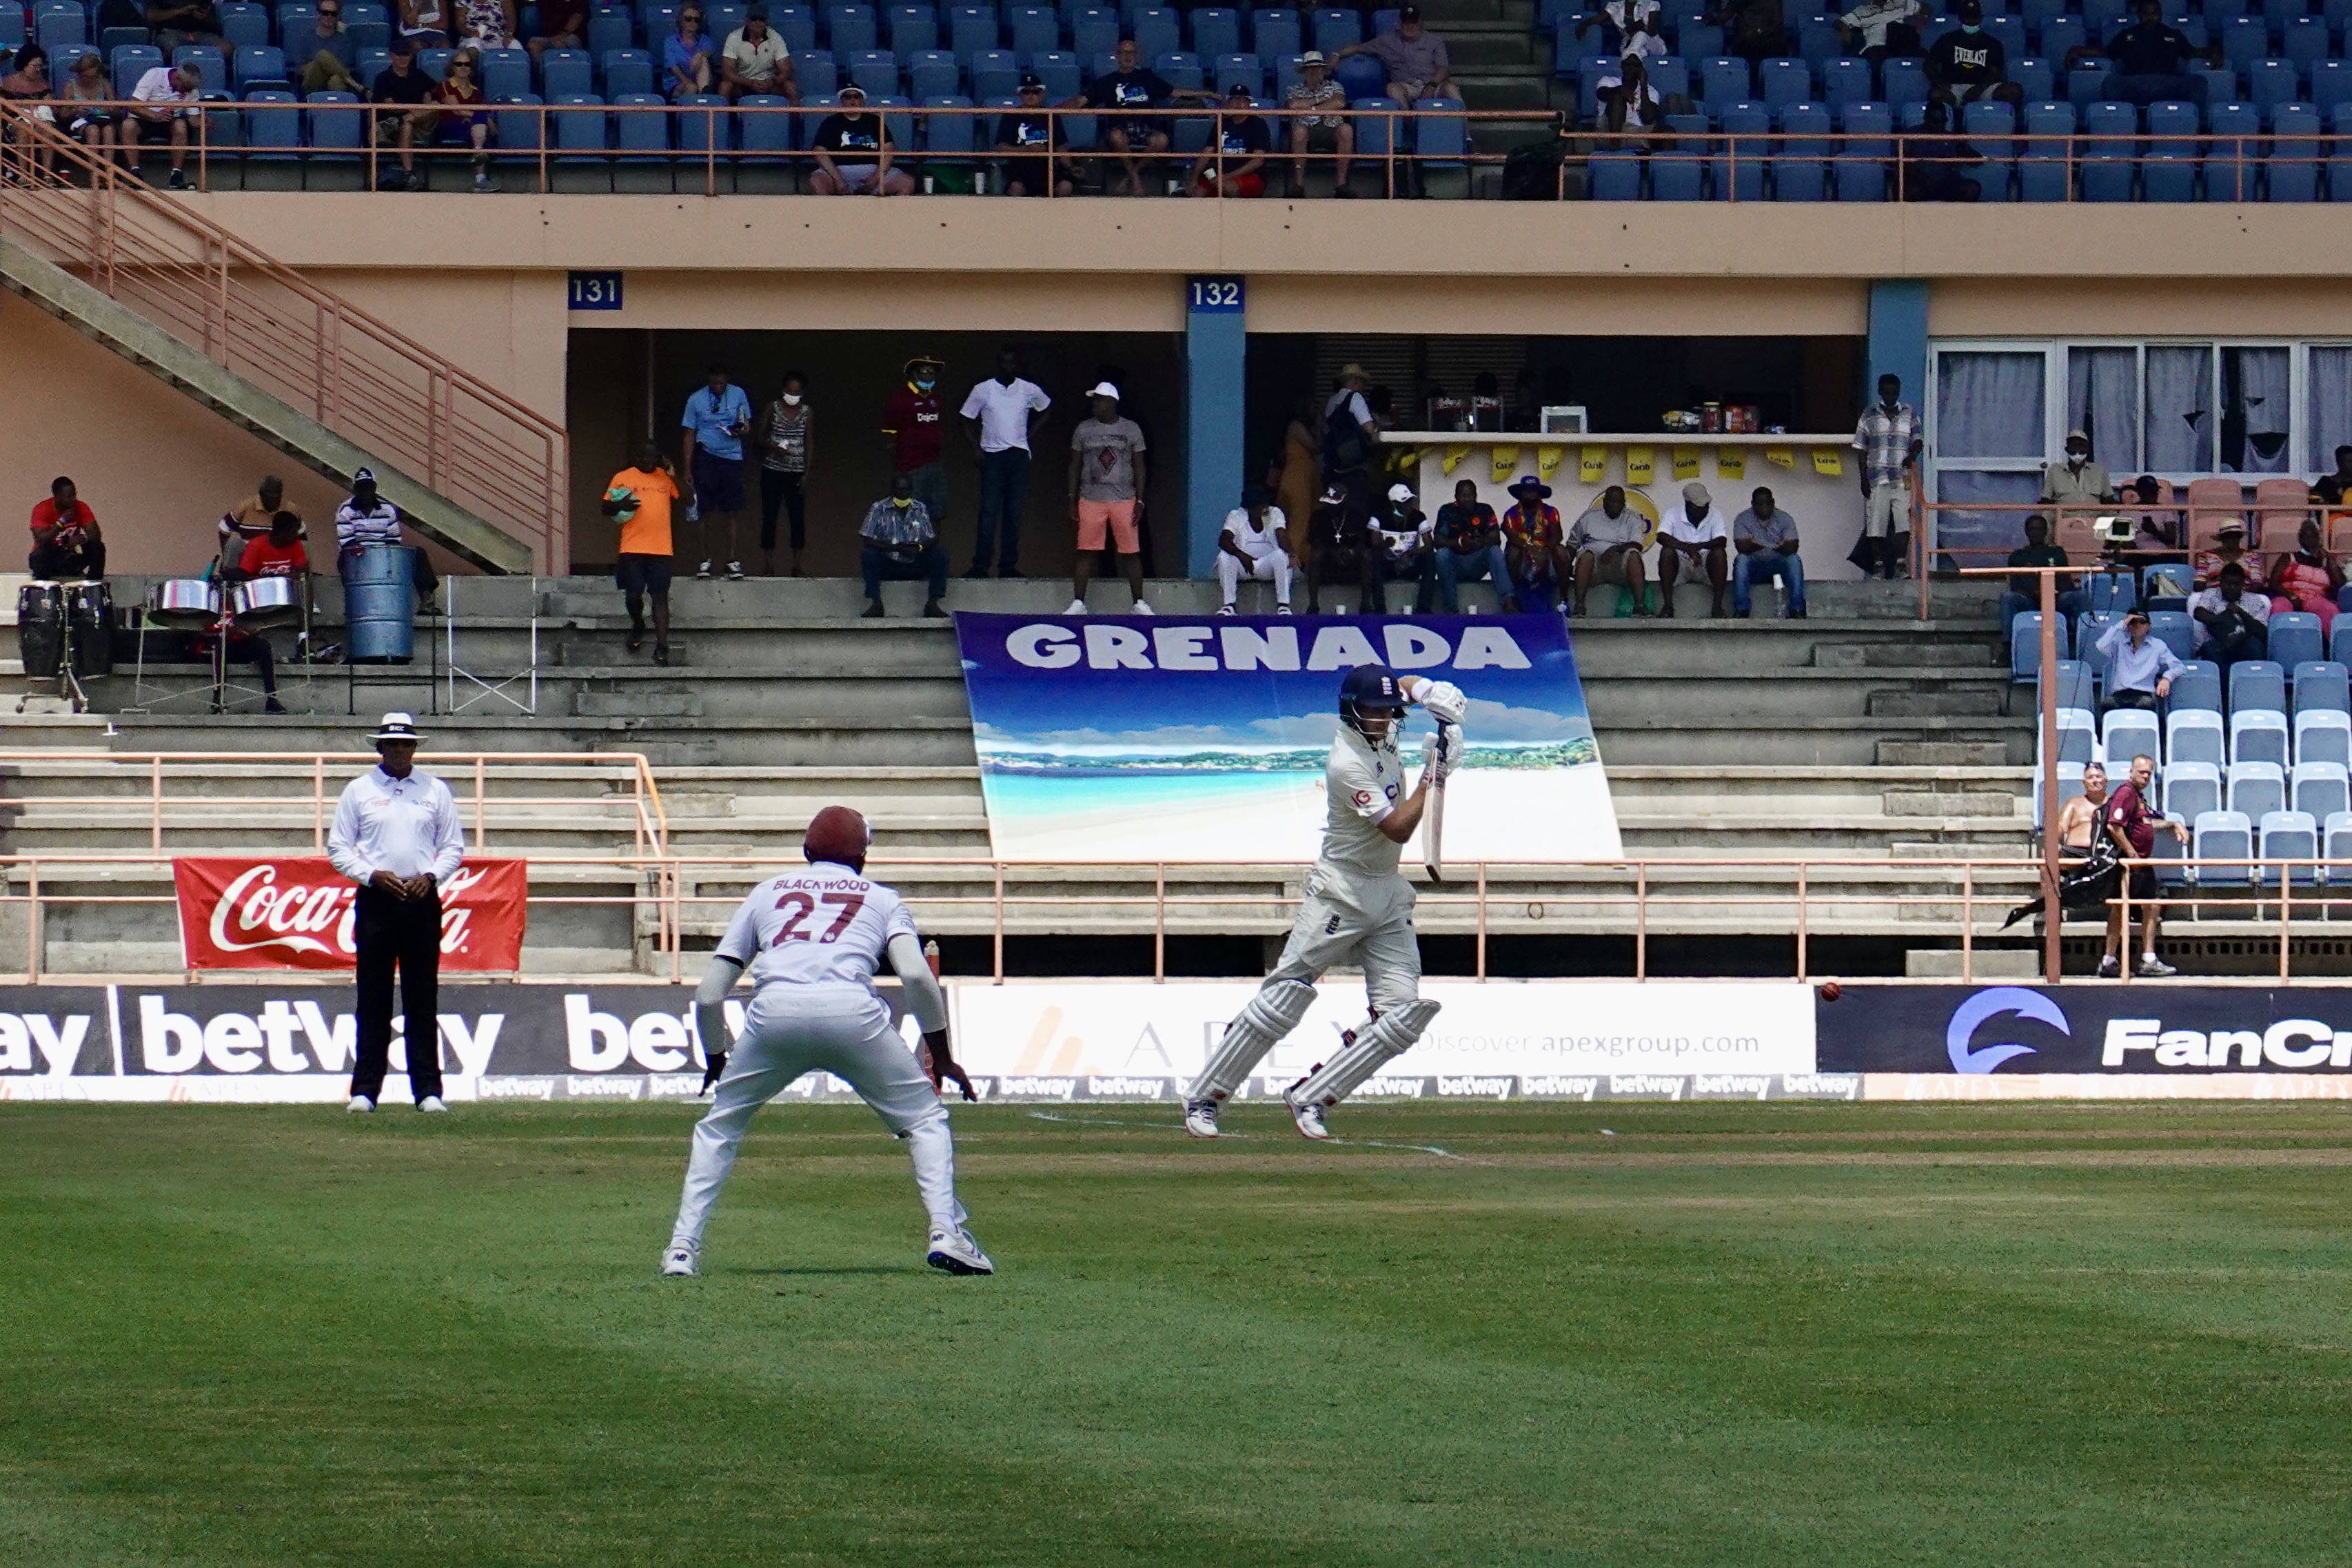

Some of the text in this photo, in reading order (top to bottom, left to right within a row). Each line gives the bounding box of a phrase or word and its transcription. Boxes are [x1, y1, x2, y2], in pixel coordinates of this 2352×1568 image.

[1954, 45, 1988, 67] EVERLAST
[574, 279, 615, 303] 131
[1193, 282, 1239, 305] 132
[1006, 622, 1533, 672] GRENADA
[1350, 789, 1372, 808] IG
[772, 891, 866, 947] 27
[1417, 1030, 1759, 1057] Discover apexgroup.com
[478, 1077, 554, 1100] betway
[567, 1075, 642, 1100] betway
[1000, 1075, 1076, 1100] betway
[1088, 1076, 1165, 1099] betway
[1437, 1075, 1513, 1101] betway
[1521, 1075, 1597, 1101] betway
[1610, 1074, 1685, 1101] betway
[1695, 1074, 1771, 1101] betway
[1783, 1074, 1858, 1100] betway
